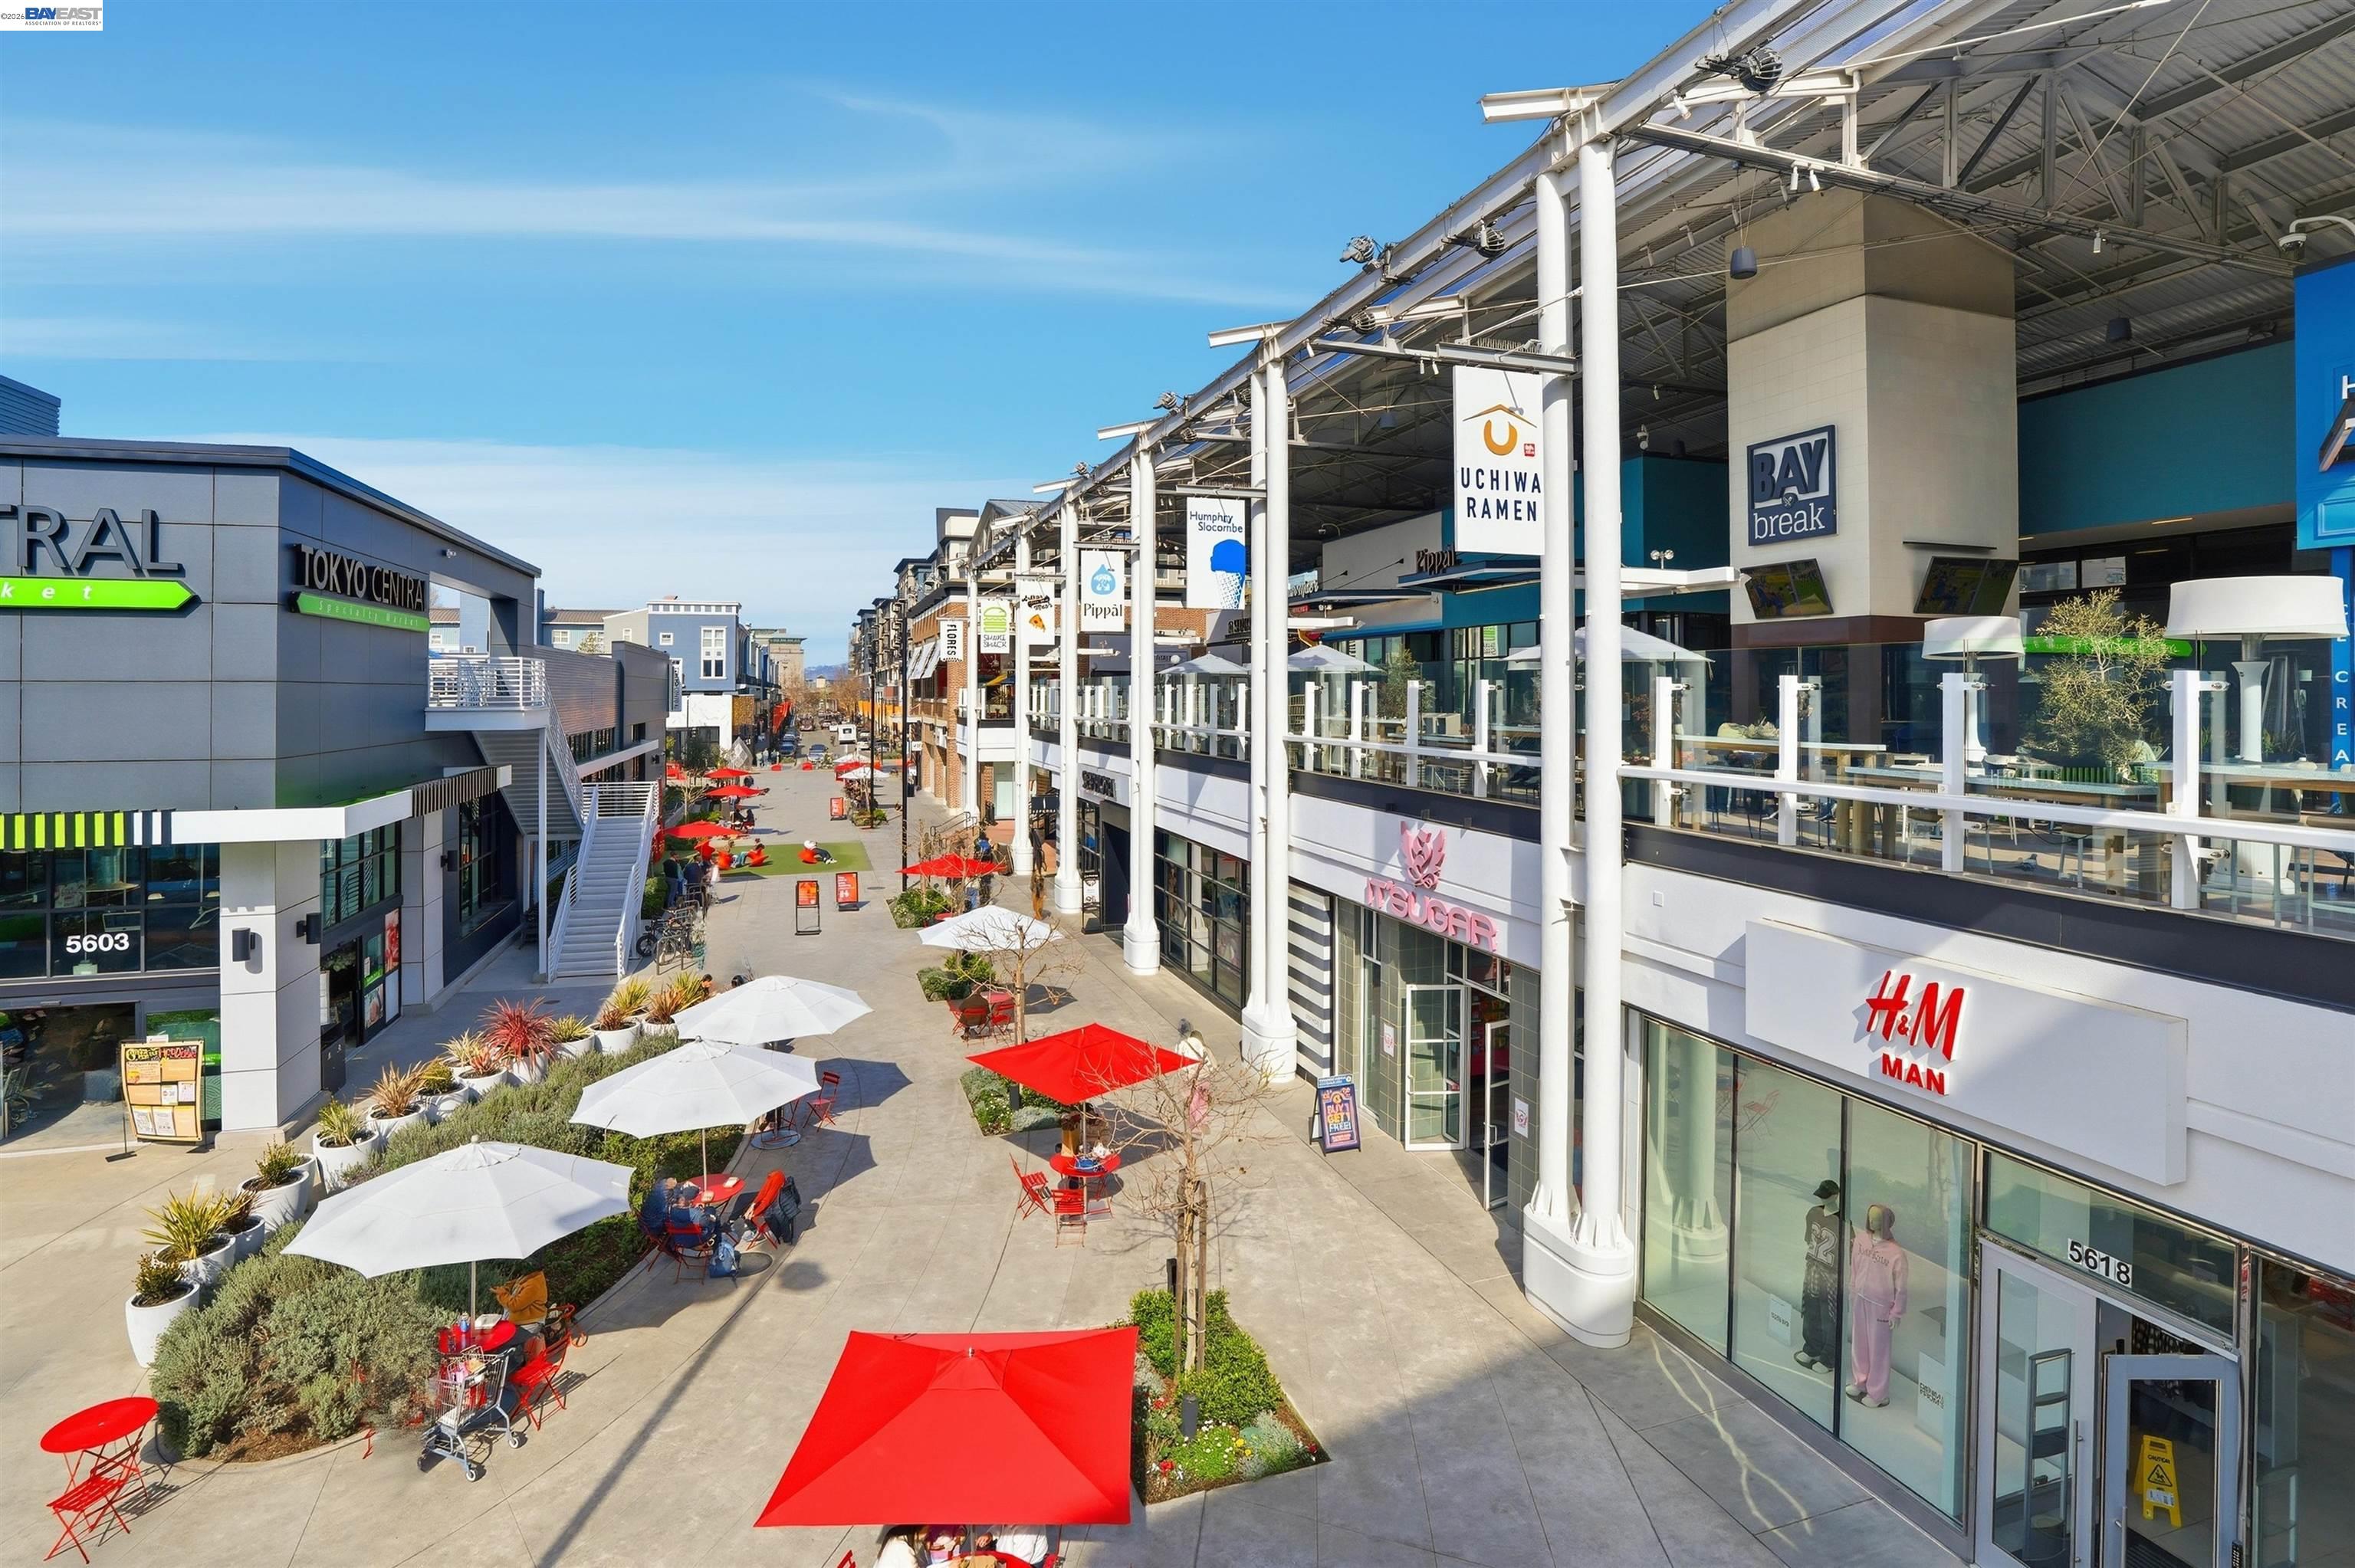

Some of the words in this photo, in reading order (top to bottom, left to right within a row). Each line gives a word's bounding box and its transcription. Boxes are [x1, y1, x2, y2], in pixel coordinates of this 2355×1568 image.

[1460, 466, 1542, 494] UCHIWA
[1754, 438, 1826, 504] BAY
[1190, 511, 1233, 524] Humphry
[1198, 522, 1243, 533] Slocombe
[1467, 497, 1537, 522] RAMEN
[1753, 502, 1825, 540] break
[0, 504, 179, 570] RAL
[301, 544, 367, 599] TOKYO
[372, 566, 425, 611] CENTRA
[947, 624, 957, 656] FLORES
[1367, 877, 1497, 952] IT'SUGAR
[66, 933, 130, 953] 5603
[1865, 970, 1965, 1061] H&M
[1882, 1053, 1946, 1096] MAN
[2069, 1241, 2131, 1285] 5618
